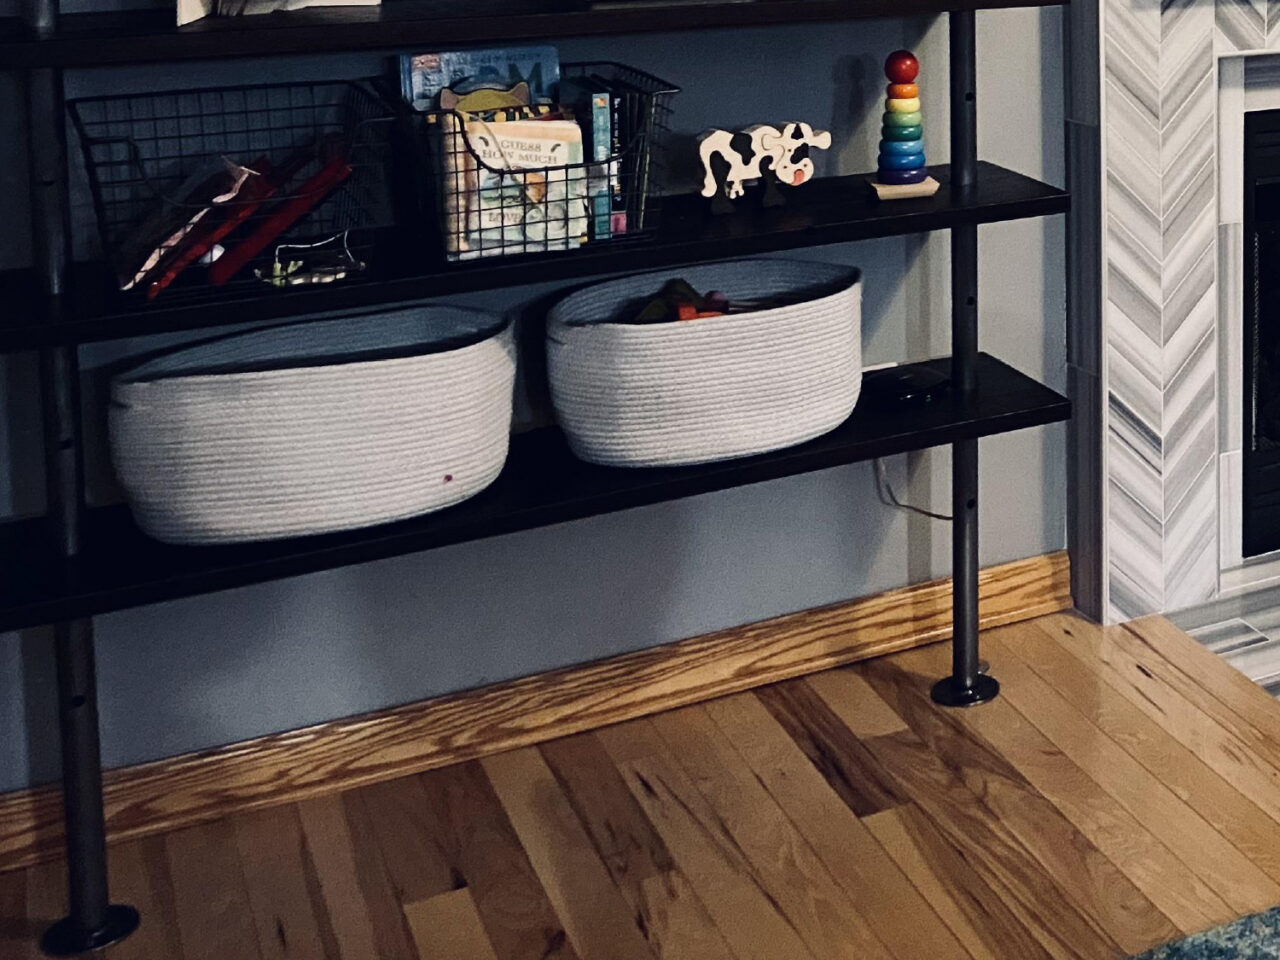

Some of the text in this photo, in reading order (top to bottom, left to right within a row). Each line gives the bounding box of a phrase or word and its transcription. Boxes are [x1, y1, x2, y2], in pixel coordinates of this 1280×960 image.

[501, 139, 542, 153] GUESS
[482, 149, 558, 164] HOW MUCH
